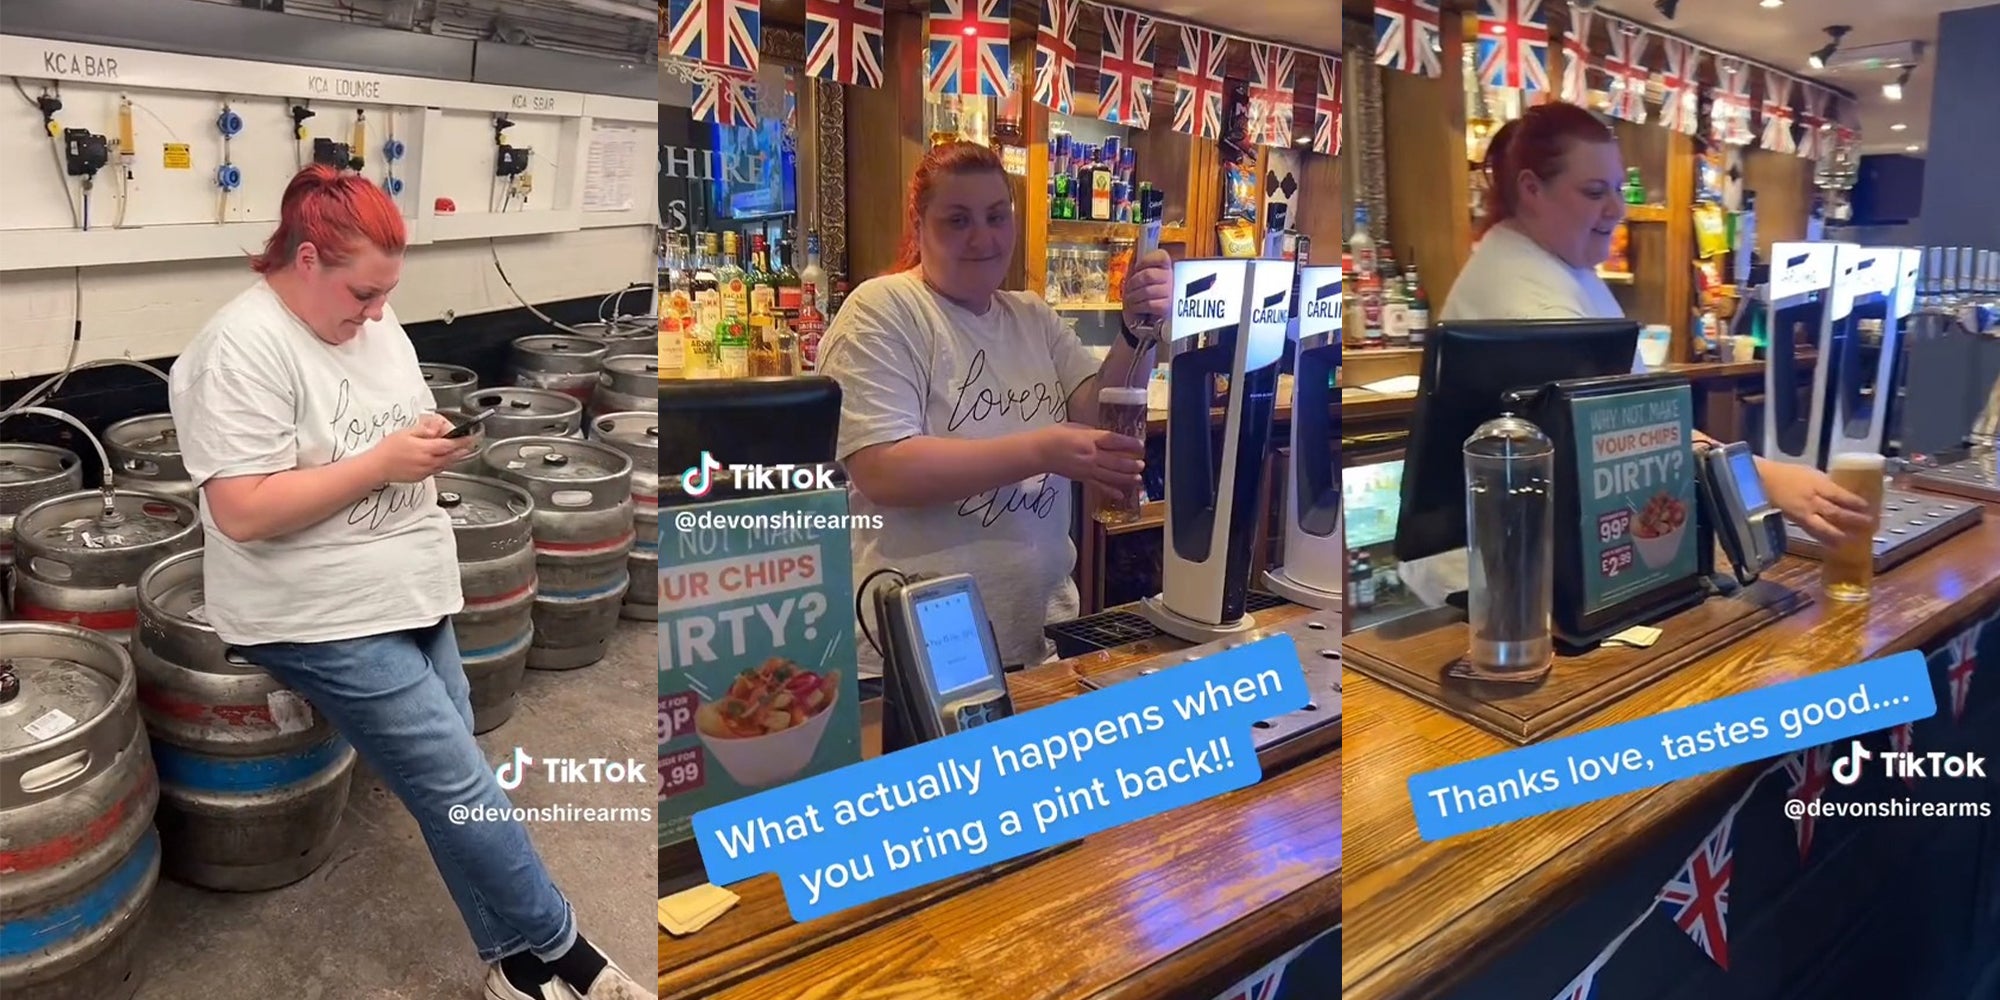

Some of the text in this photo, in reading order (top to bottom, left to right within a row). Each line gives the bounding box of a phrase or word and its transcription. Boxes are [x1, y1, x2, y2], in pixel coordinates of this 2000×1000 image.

[85, 56, 118, 78] BAR
[308, 76, 380, 98] KCA LOUNGE
[658, 144, 765, 185] HIRE
[1178, 299, 1225, 319] CARLING
[1591, 399, 1680, 431] WHY NOT MAKE
[1595, 426, 1678, 457] YOUR CHIPS
[1594, 449, 1683, 500] DIRTY?
[658, 555, 816, 601] UR CHIPS
